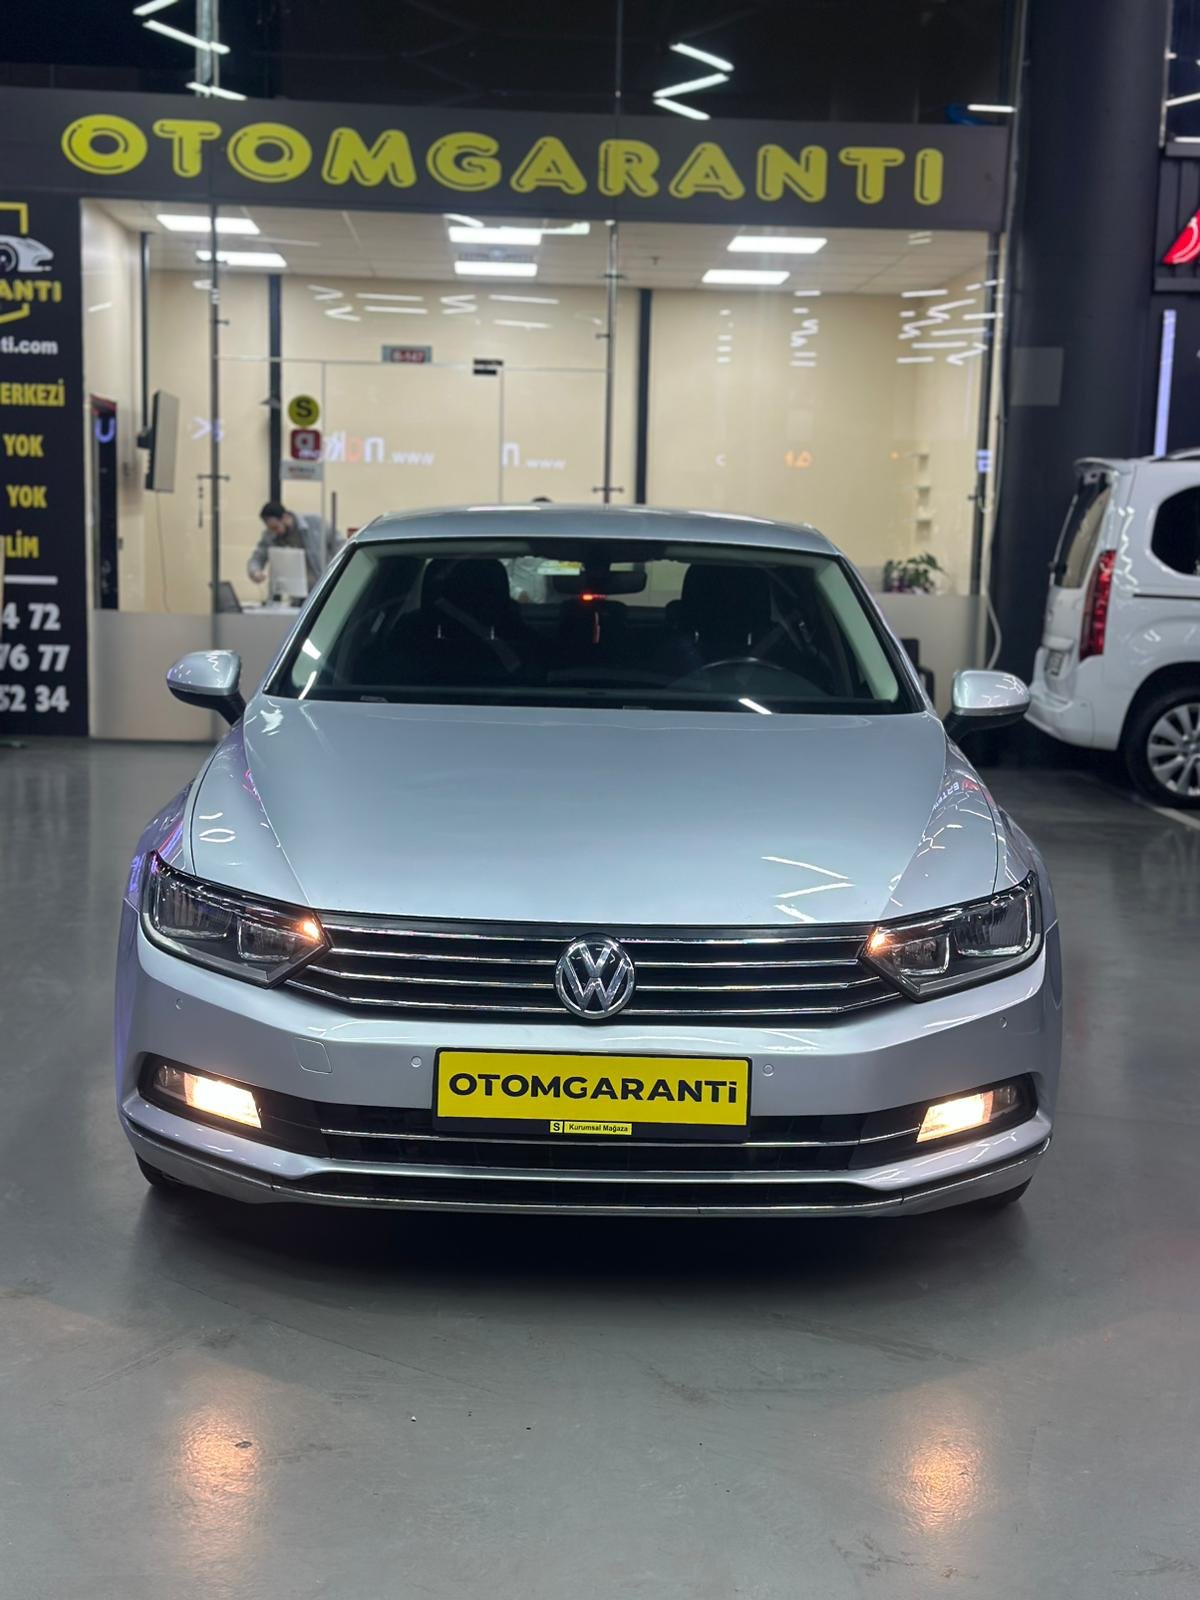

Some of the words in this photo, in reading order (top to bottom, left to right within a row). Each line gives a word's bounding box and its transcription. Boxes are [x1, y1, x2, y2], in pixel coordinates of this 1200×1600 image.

[61, 113, 944, 207] OTOMGARANTI
[0, 378, 65, 408] ERKEZİ
[295, 399, 313, 418] S
[3, 433, 45, 458] YOK
[6, 484, 48, 510] YOK
[4, 529, 39, 559] LİM
[28, 602, 62, 631] 72
[38, 643, 71, 673] 77
[35, 684, 70, 714] 34
[568, 1123, 602, 1132] Kurumsal
[603, 1124, 629, 1133] Mağaza
